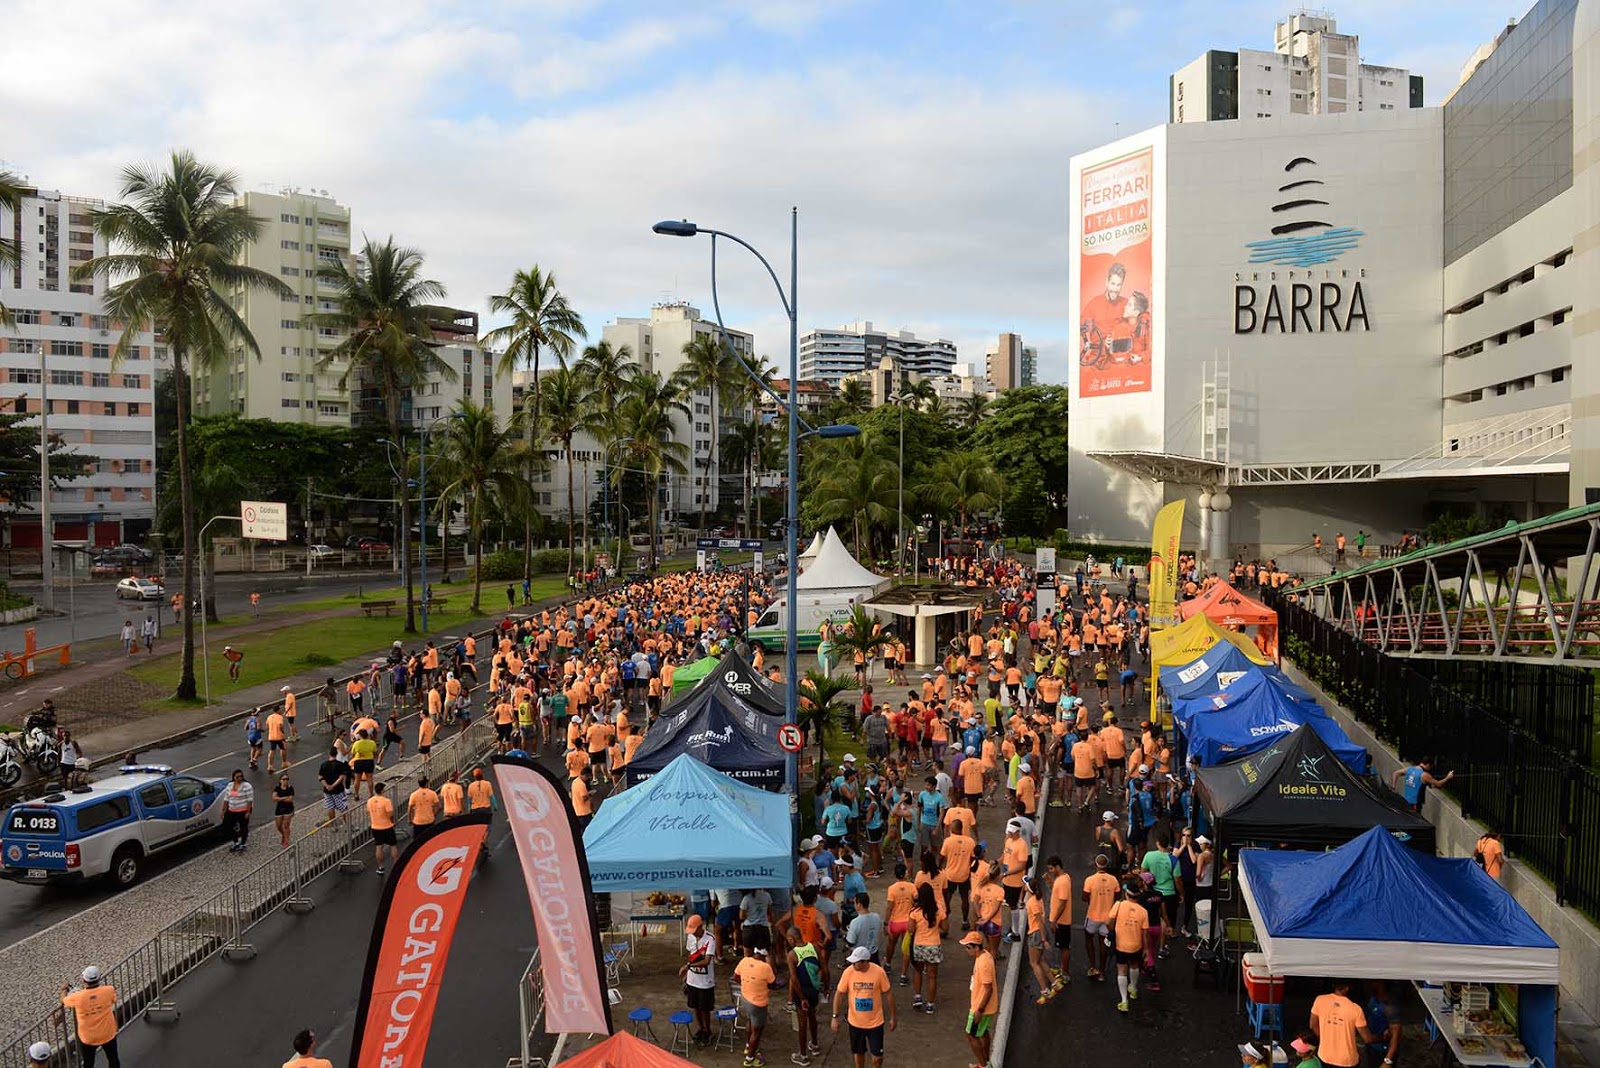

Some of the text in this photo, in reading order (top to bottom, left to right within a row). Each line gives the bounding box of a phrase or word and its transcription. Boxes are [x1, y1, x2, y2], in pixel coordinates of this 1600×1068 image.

[1084, 174, 1149, 208] FERRARI
[1087, 203, 1146, 231] ITALIA
[1098, 231, 1112, 243] NO
[1114, 222, 1148, 239] BARRA
[1235, 268, 1366, 281] SHOPPING
[1234, 281, 1371, 335] BARRA
[705, 729, 728, 741] Run
[650, 784, 720, 807] Corpus
[1279, 783, 1347, 796] Ideale Vita
[13, 816, 57, 829] R. 0133
[648, 814, 718, 832] Vitalle
